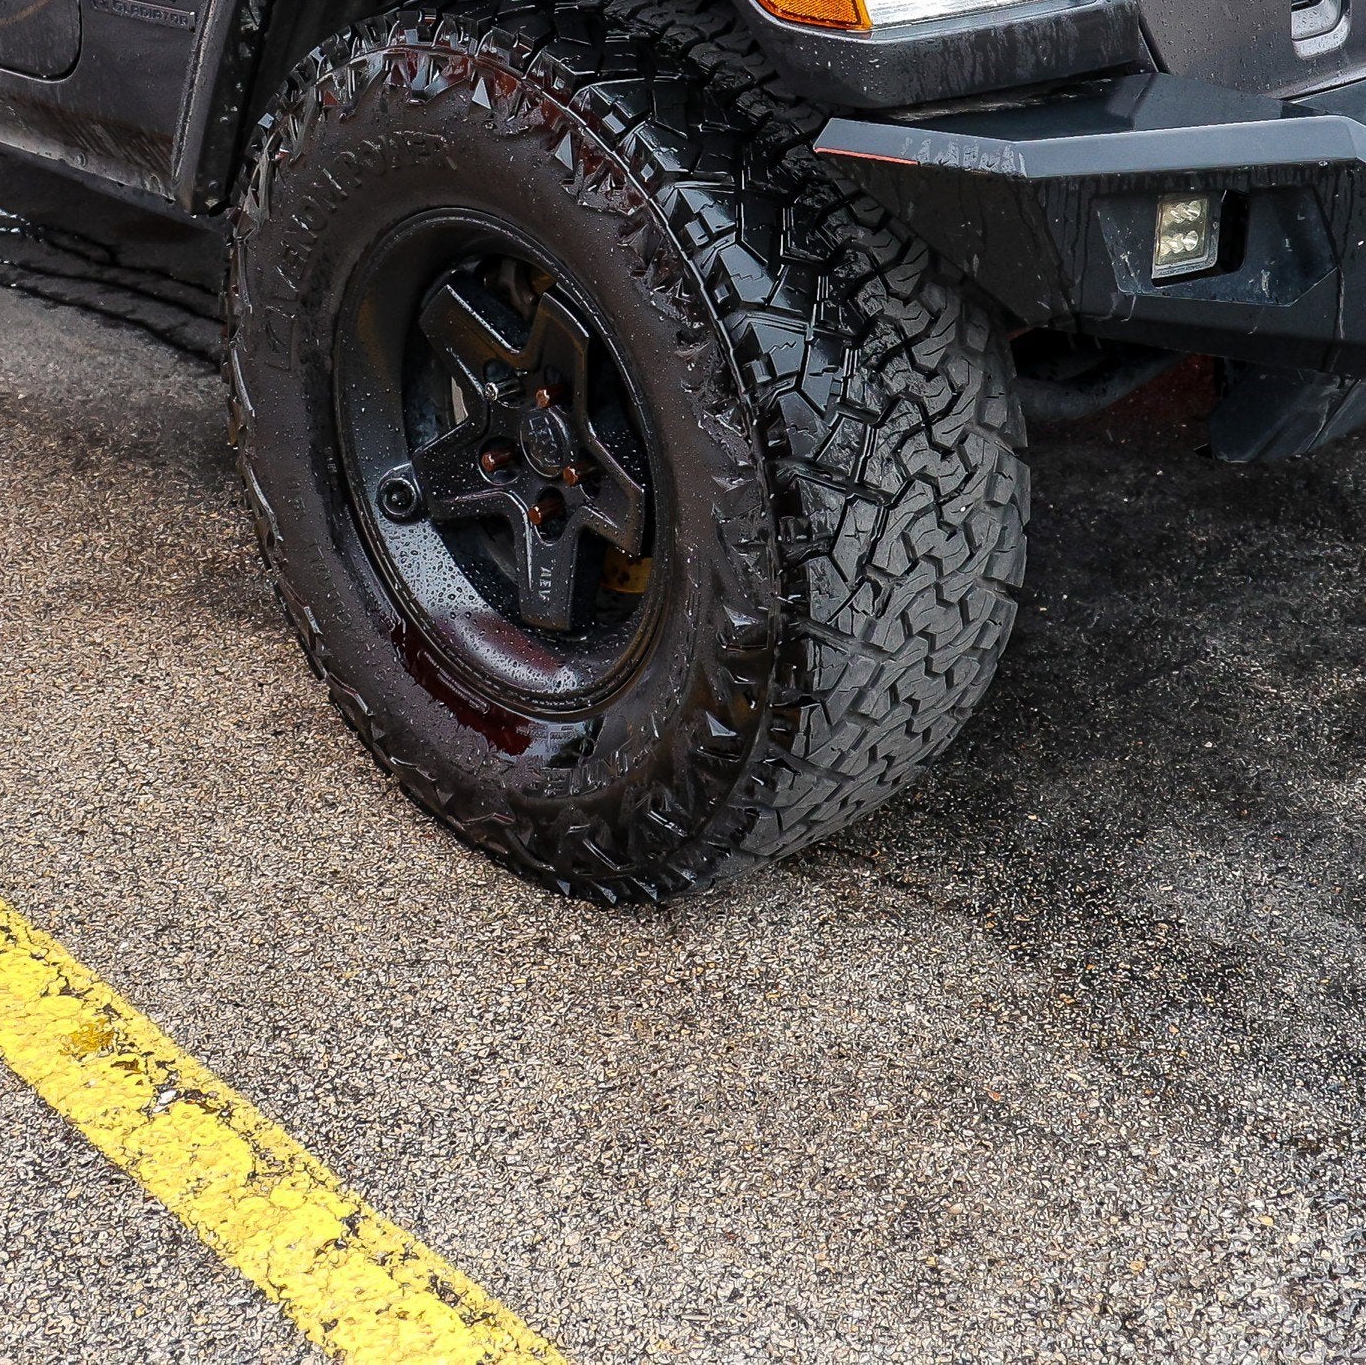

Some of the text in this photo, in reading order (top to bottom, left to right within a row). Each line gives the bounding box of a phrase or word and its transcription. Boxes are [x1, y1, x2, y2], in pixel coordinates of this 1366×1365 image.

[112, 0, 189, 27] GLADIATOR
[260, 130, 458, 302] VENOM POWER
